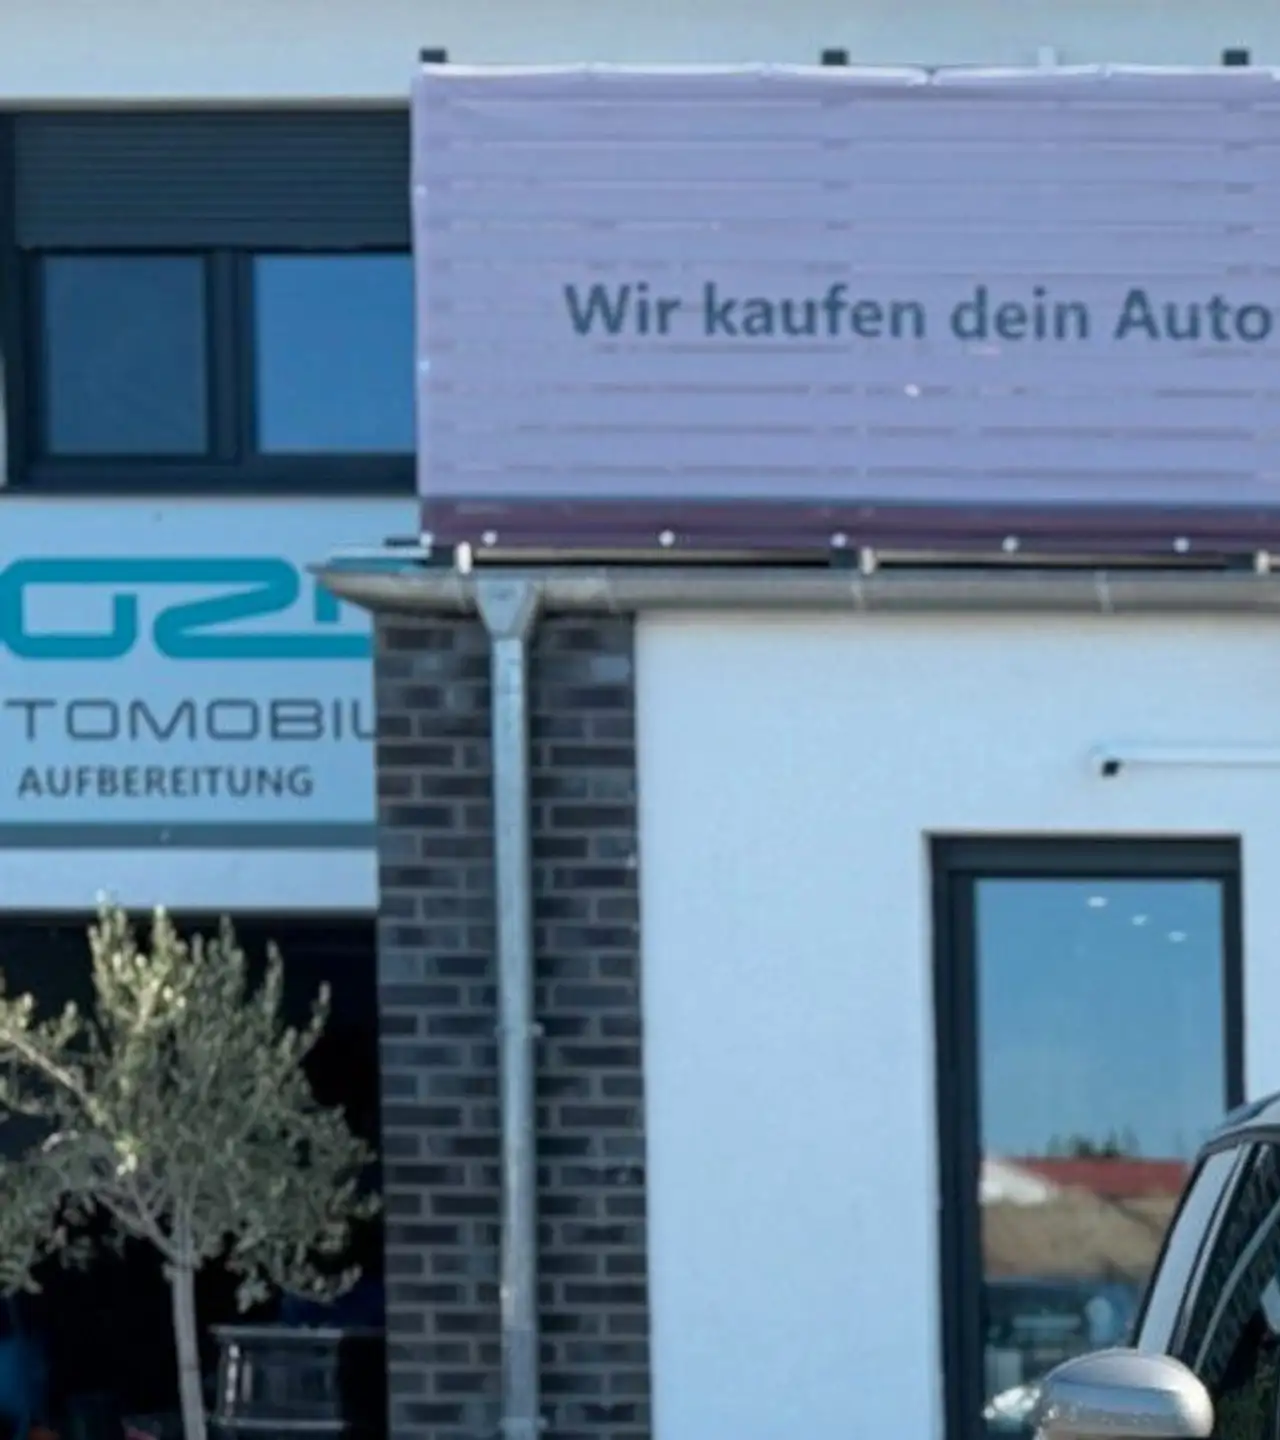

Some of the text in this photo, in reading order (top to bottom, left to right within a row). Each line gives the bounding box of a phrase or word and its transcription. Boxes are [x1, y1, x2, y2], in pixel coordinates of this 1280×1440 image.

[564, 280, 1274, 344] Wir kaufen dein Auto
[17, 765, 314, 799] AUFBEREITUNG
